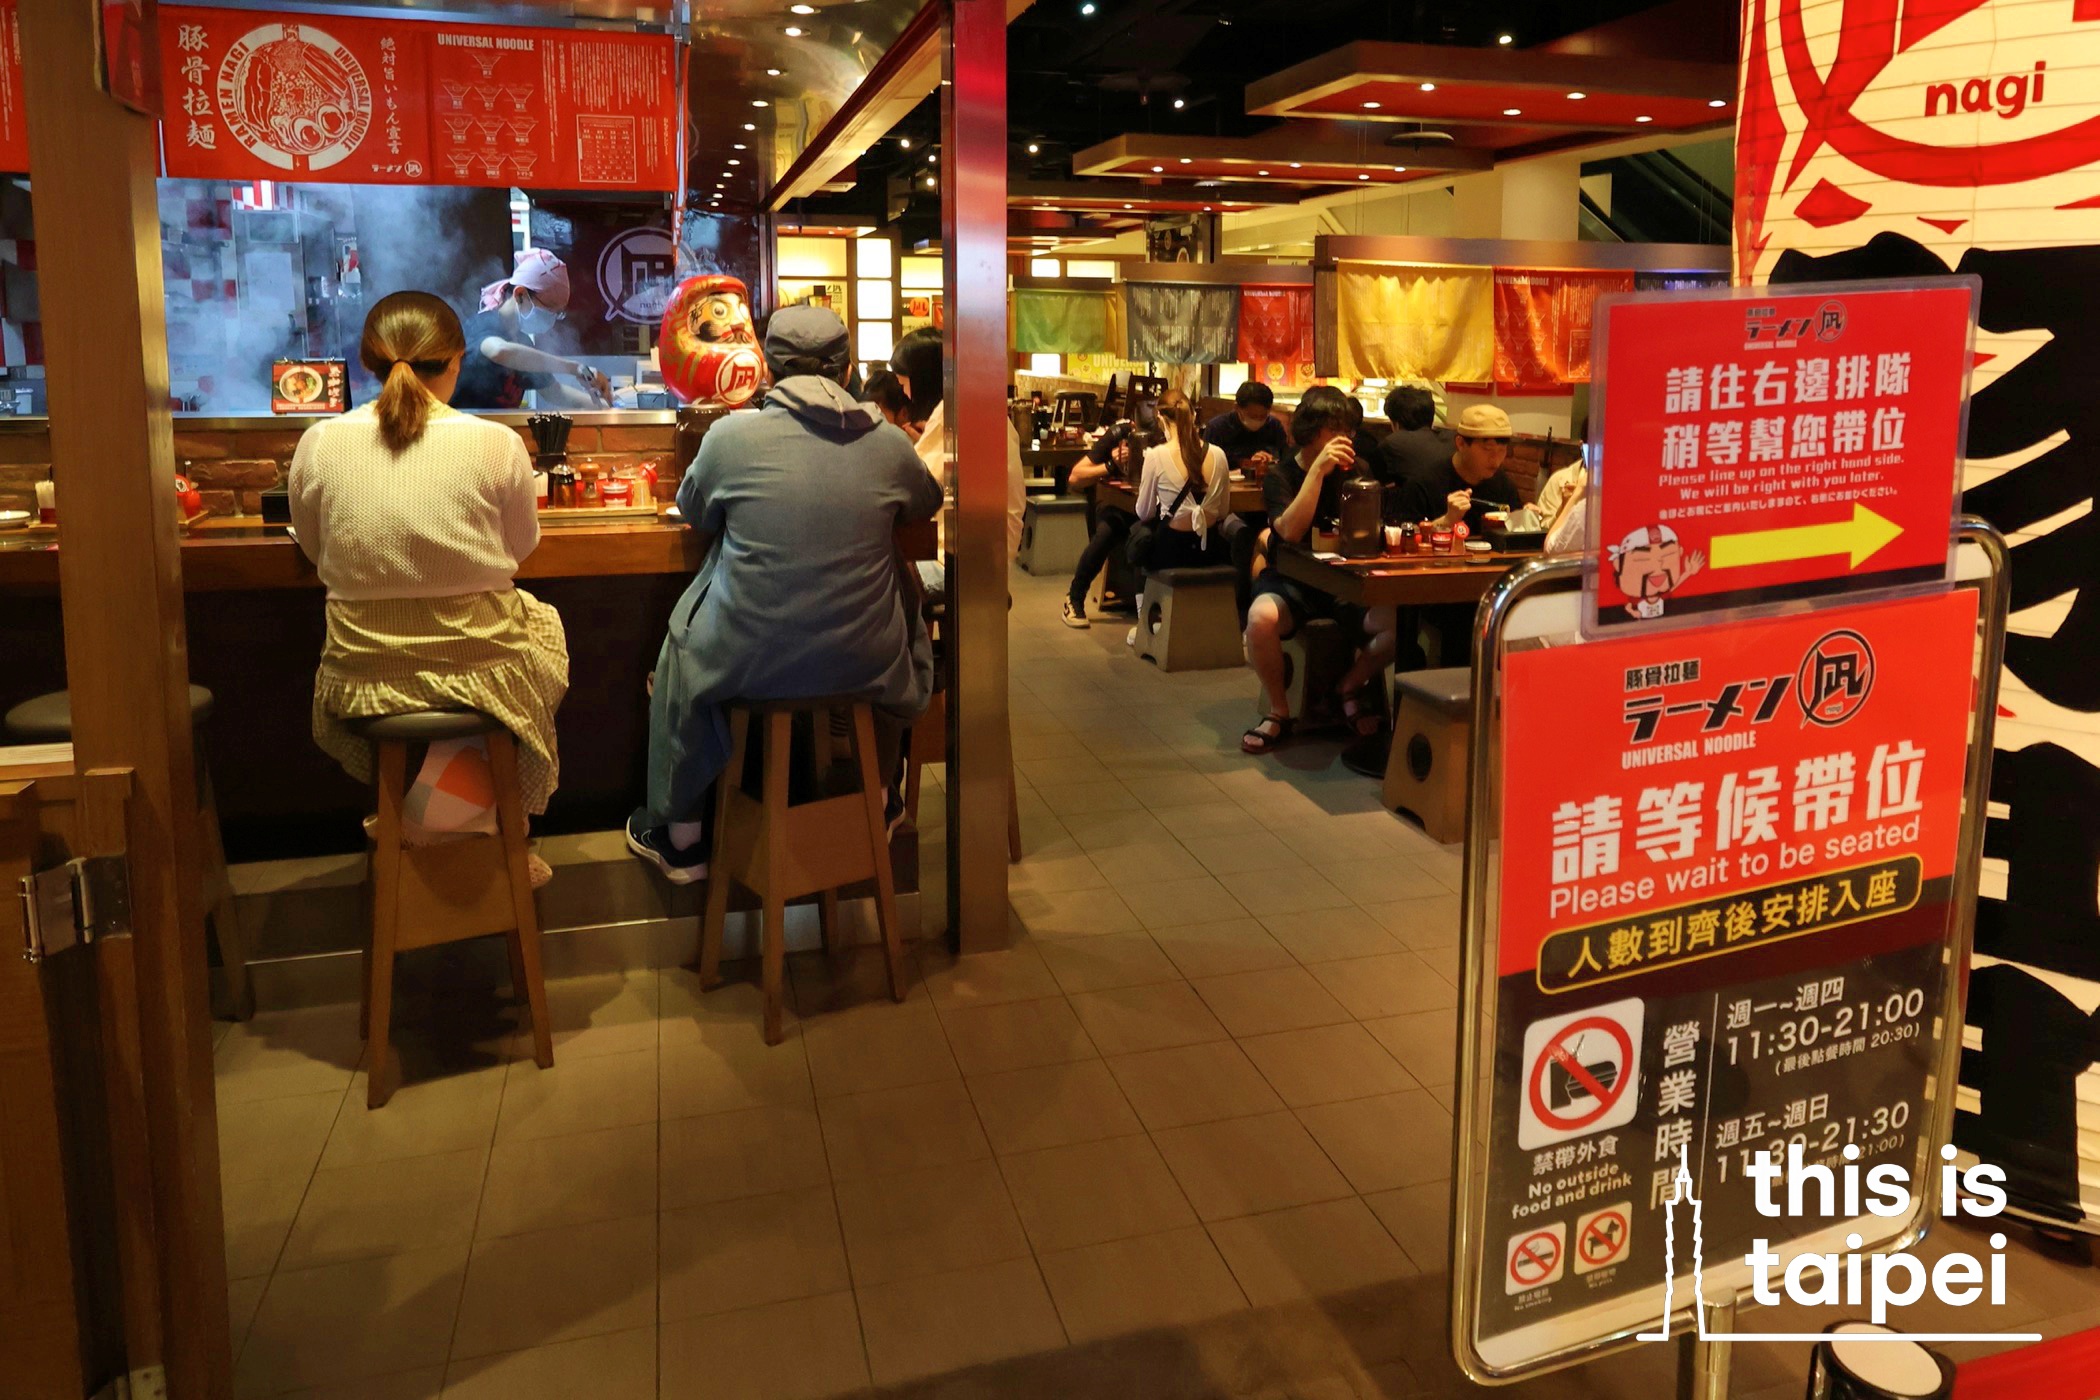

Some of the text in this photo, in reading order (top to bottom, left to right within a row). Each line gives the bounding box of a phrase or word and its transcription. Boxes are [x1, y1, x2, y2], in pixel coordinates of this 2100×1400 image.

[437, 33, 534, 51] UNIVERSAL NOODLE
[220, 41, 258, 149] RAMEN NAGI
[334, 46, 370, 107] UNIVERSAL
[1925, 60, 2047, 119] nagi
[1745, 317, 1812, 340] ラーメン
[1665, 352, 1911, 414] 請往右邊排隊
[1661, 407, 1906, 470] 稍等幫您帶位
[1659, 453, 1904, 487] Please line up on the right hand side.
[1680, 471, 1884, 500] We will be right with you later.
[1624, 659, 1700, 692] 豚骨拉麵
[1624, 648, 1869, 744] ラーメン 凪
[1622, 731, 1756, 770] UNIVERSAL NOODLE
[1552, 741, 1926, 885] 請等候帶位
[1550, 815, 1921, 919] Please wait to be seated
[1567, 870, 1899, 979] 人數到齊後安排入座
[1728, 988, 1925, 1066] 11:30-21:00
[1870, 1022, 1920, 1049] 20:30)
[1650, 1020, 1700, 1212] 營業時間
[1717, 1101, 1909, 1184] 1130-21:30
[1528, 1162, 1619, 1199] No outside
[1533, 1134, 1619, 1177] 禁帶外食
[1511, 1173, 1633, 1219] food and drink
